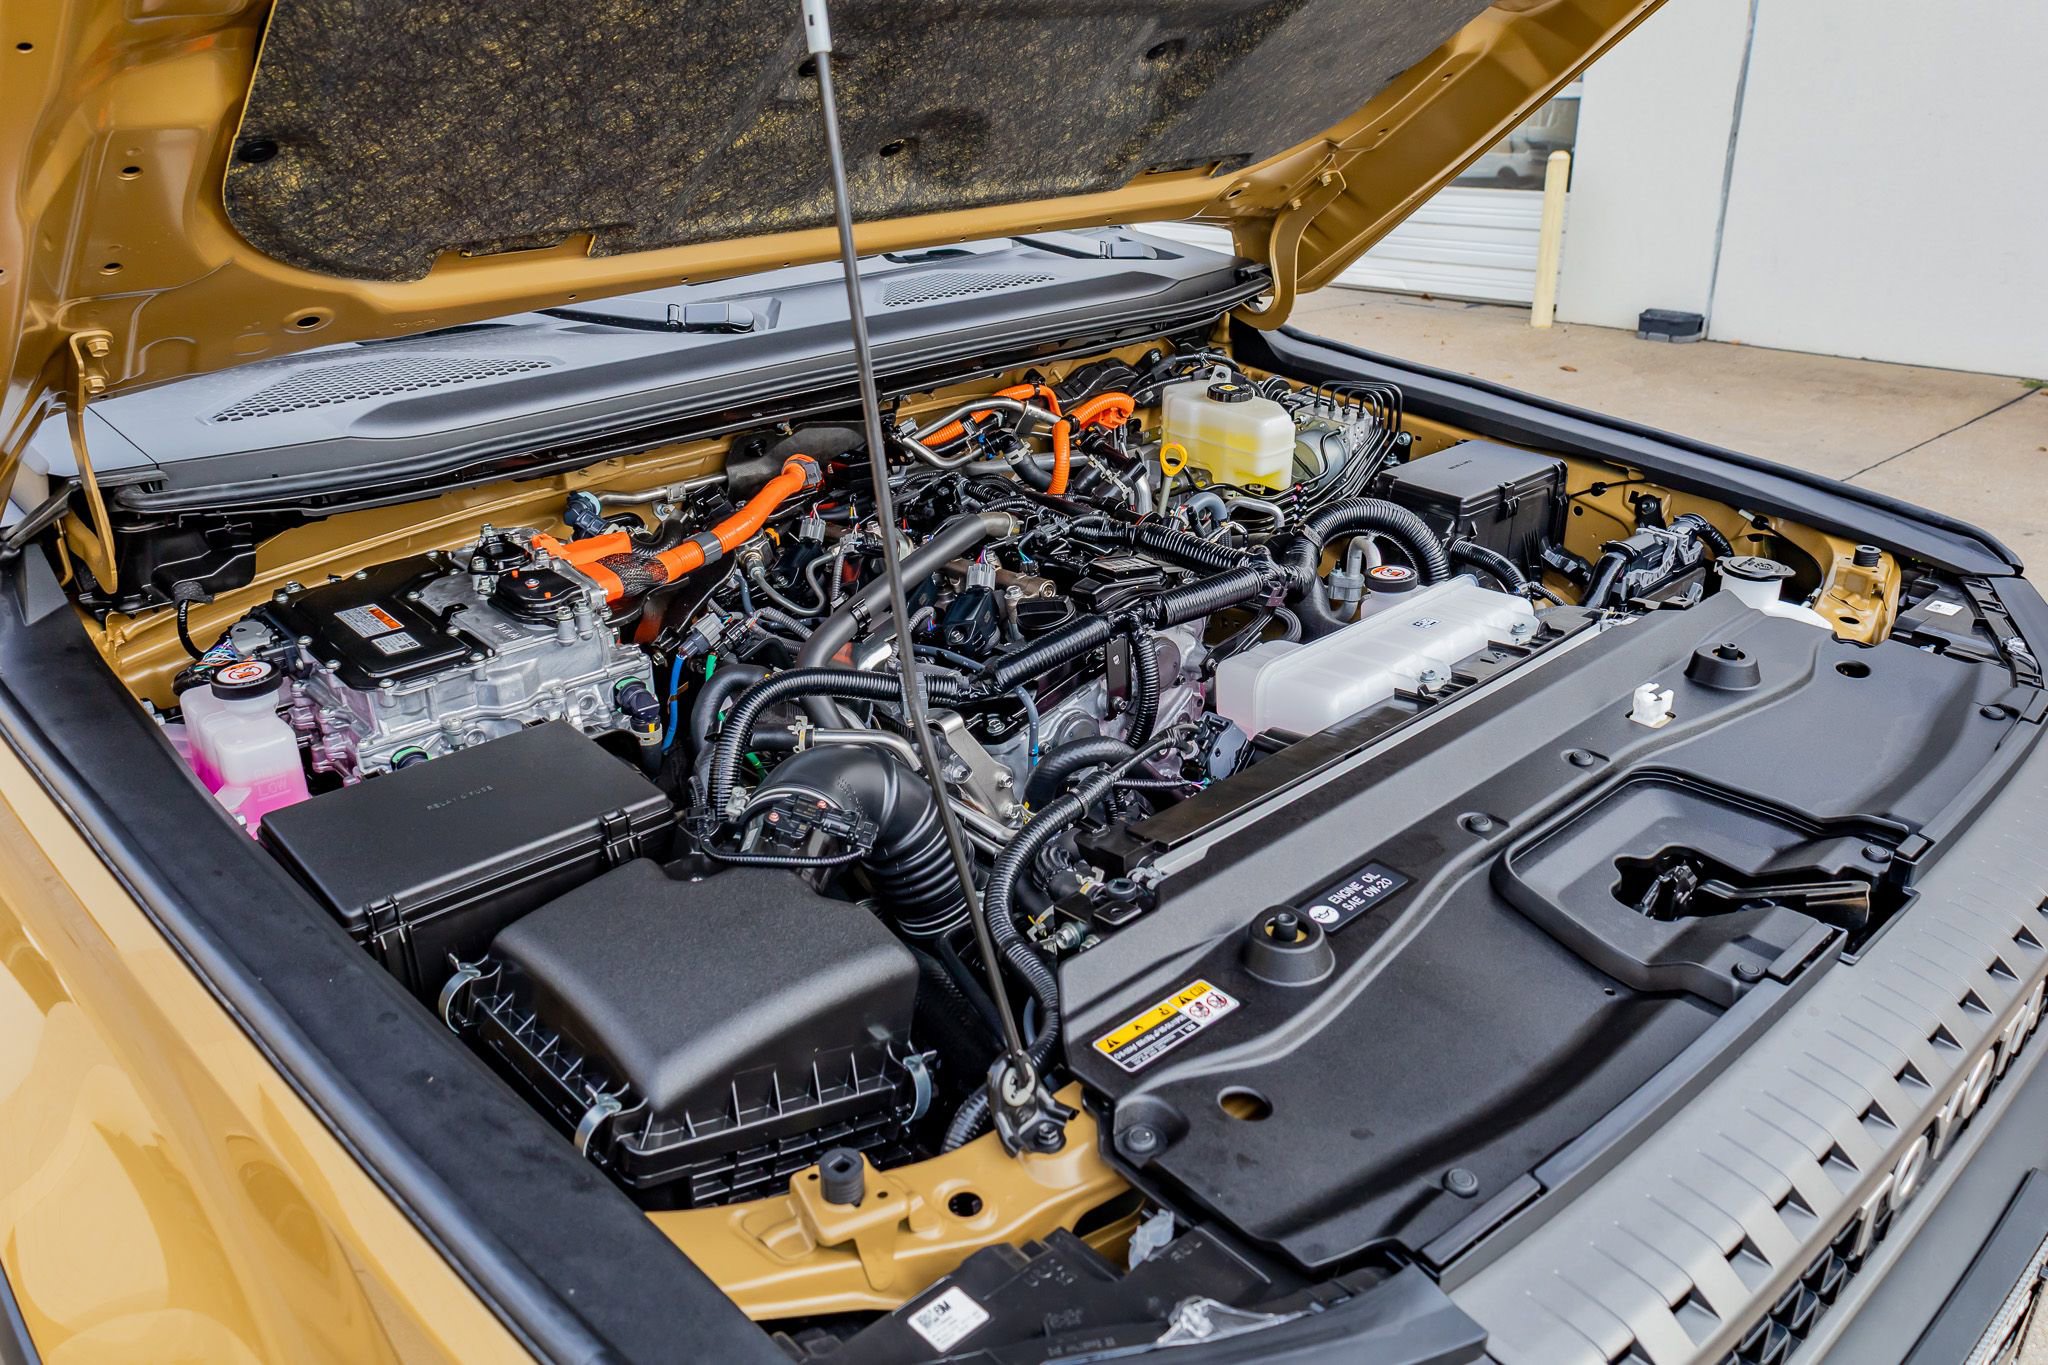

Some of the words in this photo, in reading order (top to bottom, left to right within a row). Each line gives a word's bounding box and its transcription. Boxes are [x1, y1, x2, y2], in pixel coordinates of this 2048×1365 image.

[468, 785, 494, 796] FUSE
[1328, 881, 1364, 905] ENGINE
[1361, 872, 1381, 883] OIL
[1342, 896, 1365, 911] SAE
[1363, 878, 1393, 897] 0W-20
[1857, 980, 2045, 1256] TOYOTA
